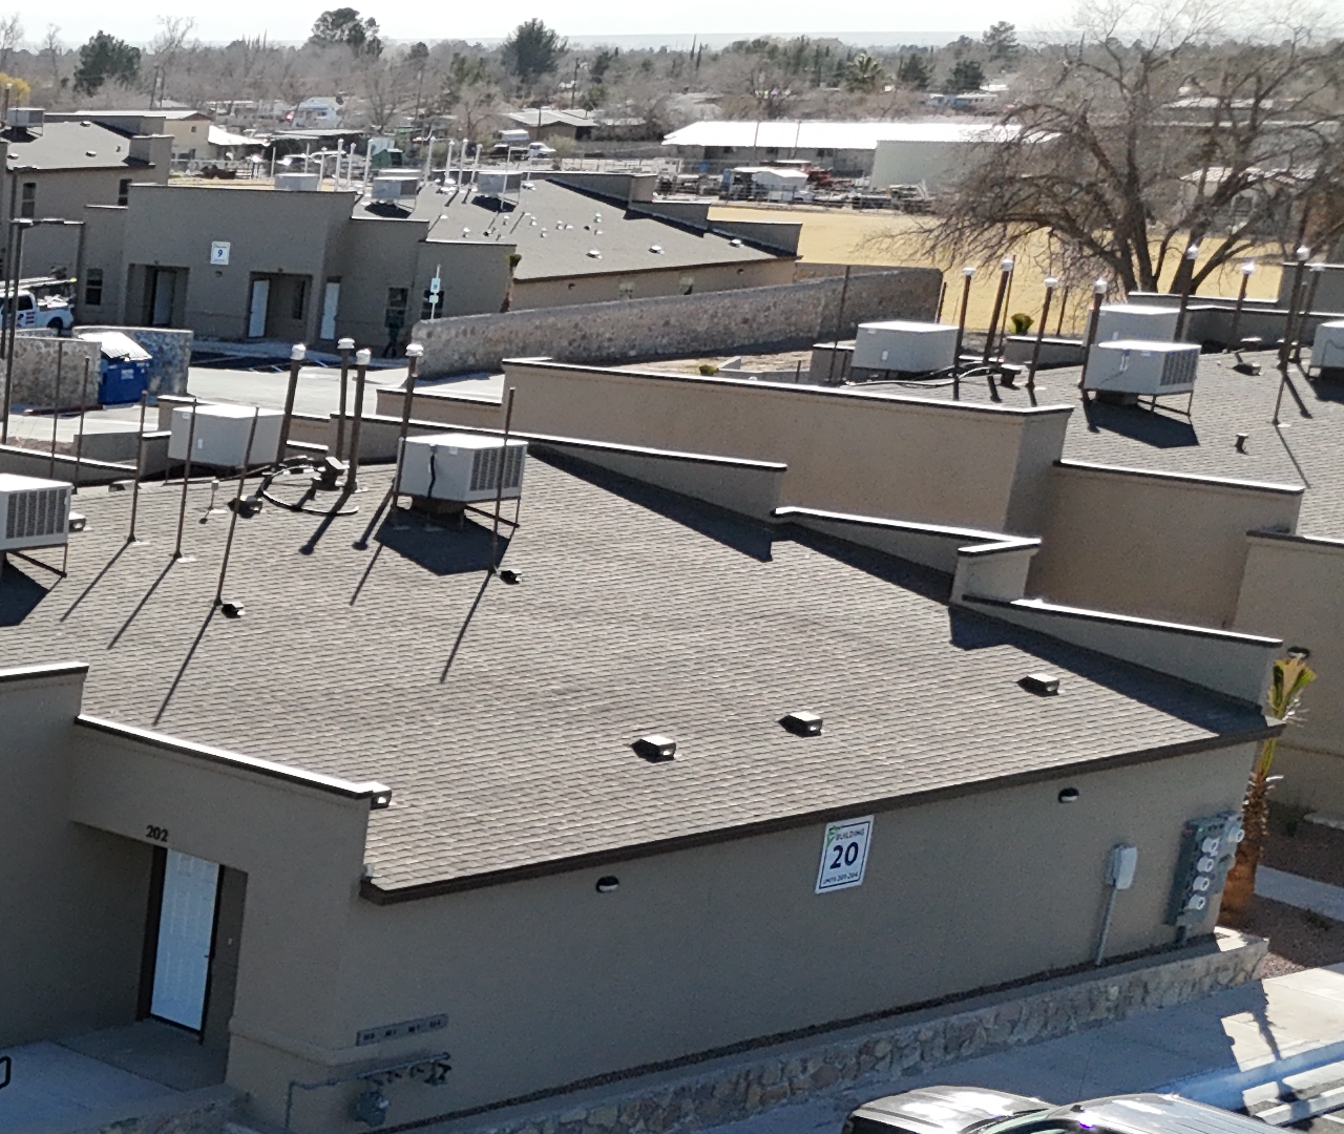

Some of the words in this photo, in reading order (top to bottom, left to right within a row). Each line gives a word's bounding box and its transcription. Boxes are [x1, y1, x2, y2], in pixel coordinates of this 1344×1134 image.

[146, 825, 169, 842] 202
[835, 828, 866, 841] BUILDING
[829, 841, 859, 870] 20
